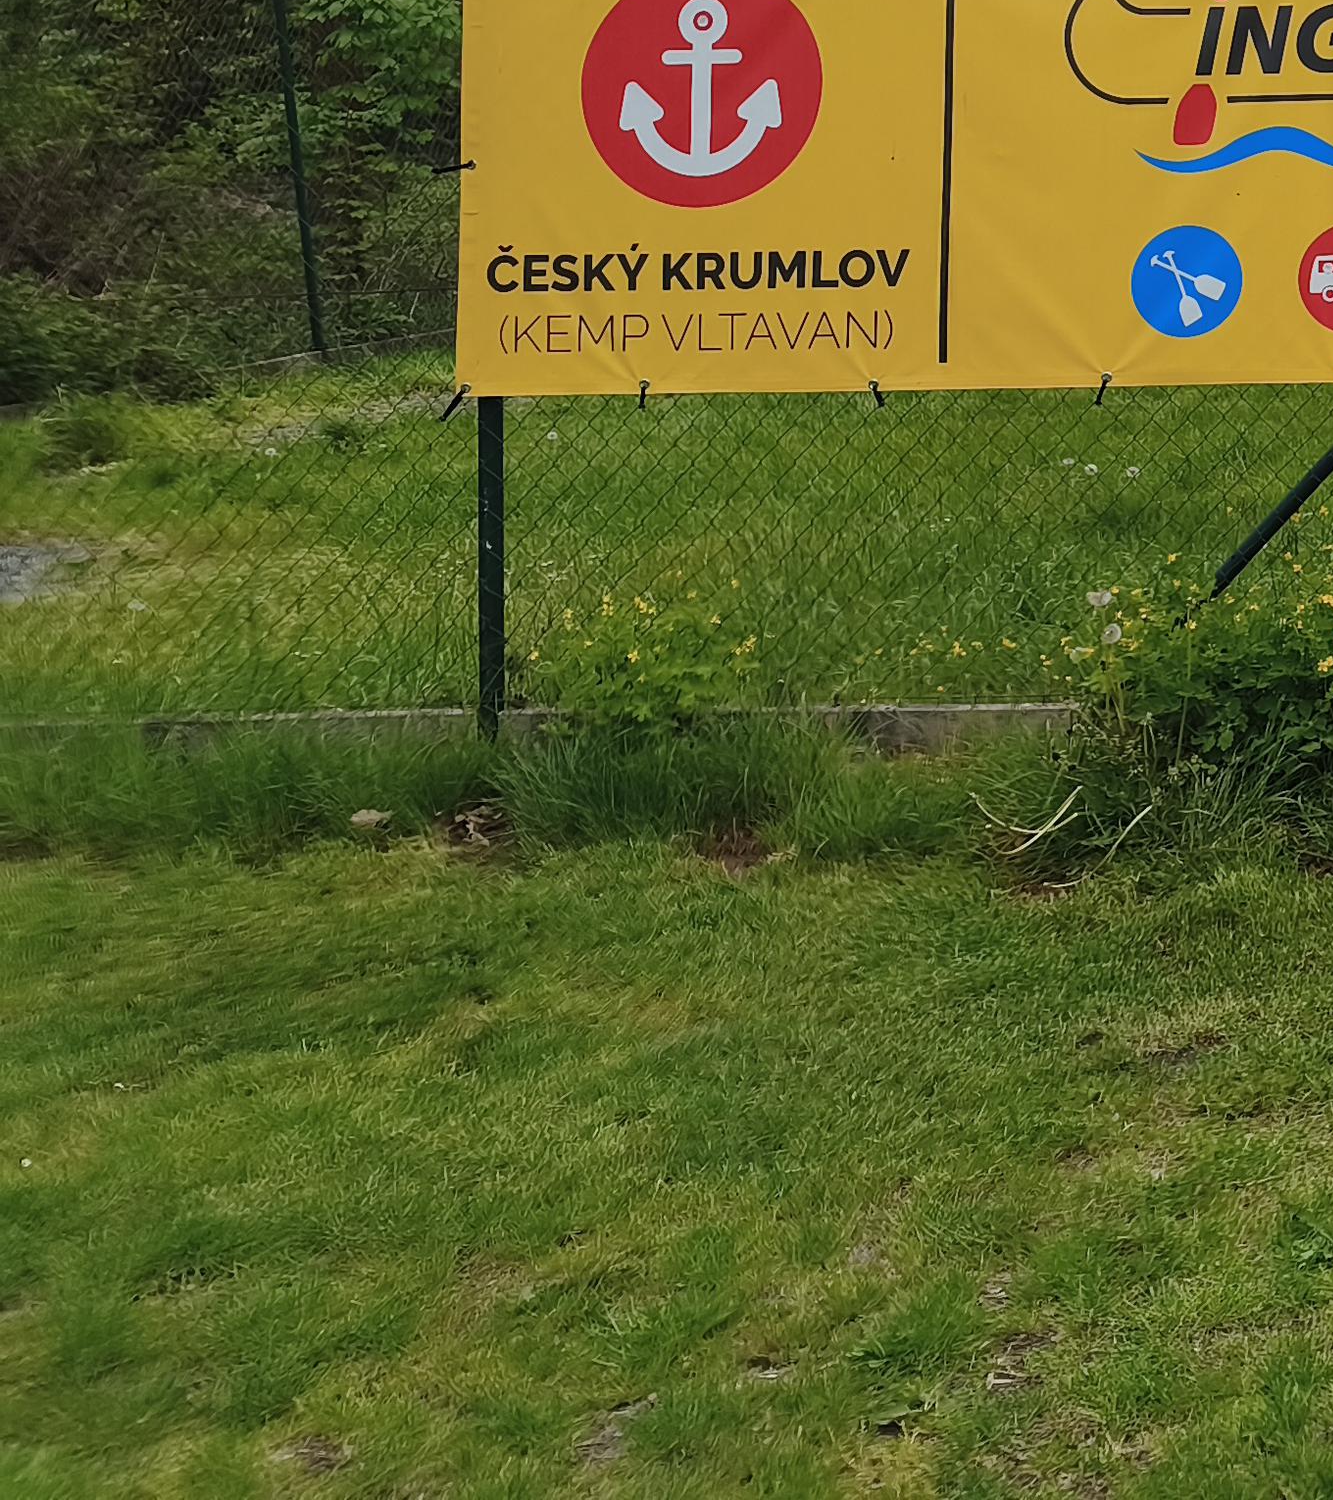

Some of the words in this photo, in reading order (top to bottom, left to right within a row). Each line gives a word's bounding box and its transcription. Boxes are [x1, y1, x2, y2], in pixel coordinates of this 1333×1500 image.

[486, 243, 650, 293] ČESKÝ
[662, 248, 910, 291] KRUMLOV
[499, 314, 650, 355] (KEMP
[661, 309, 895, 352] VLTAVAN)
